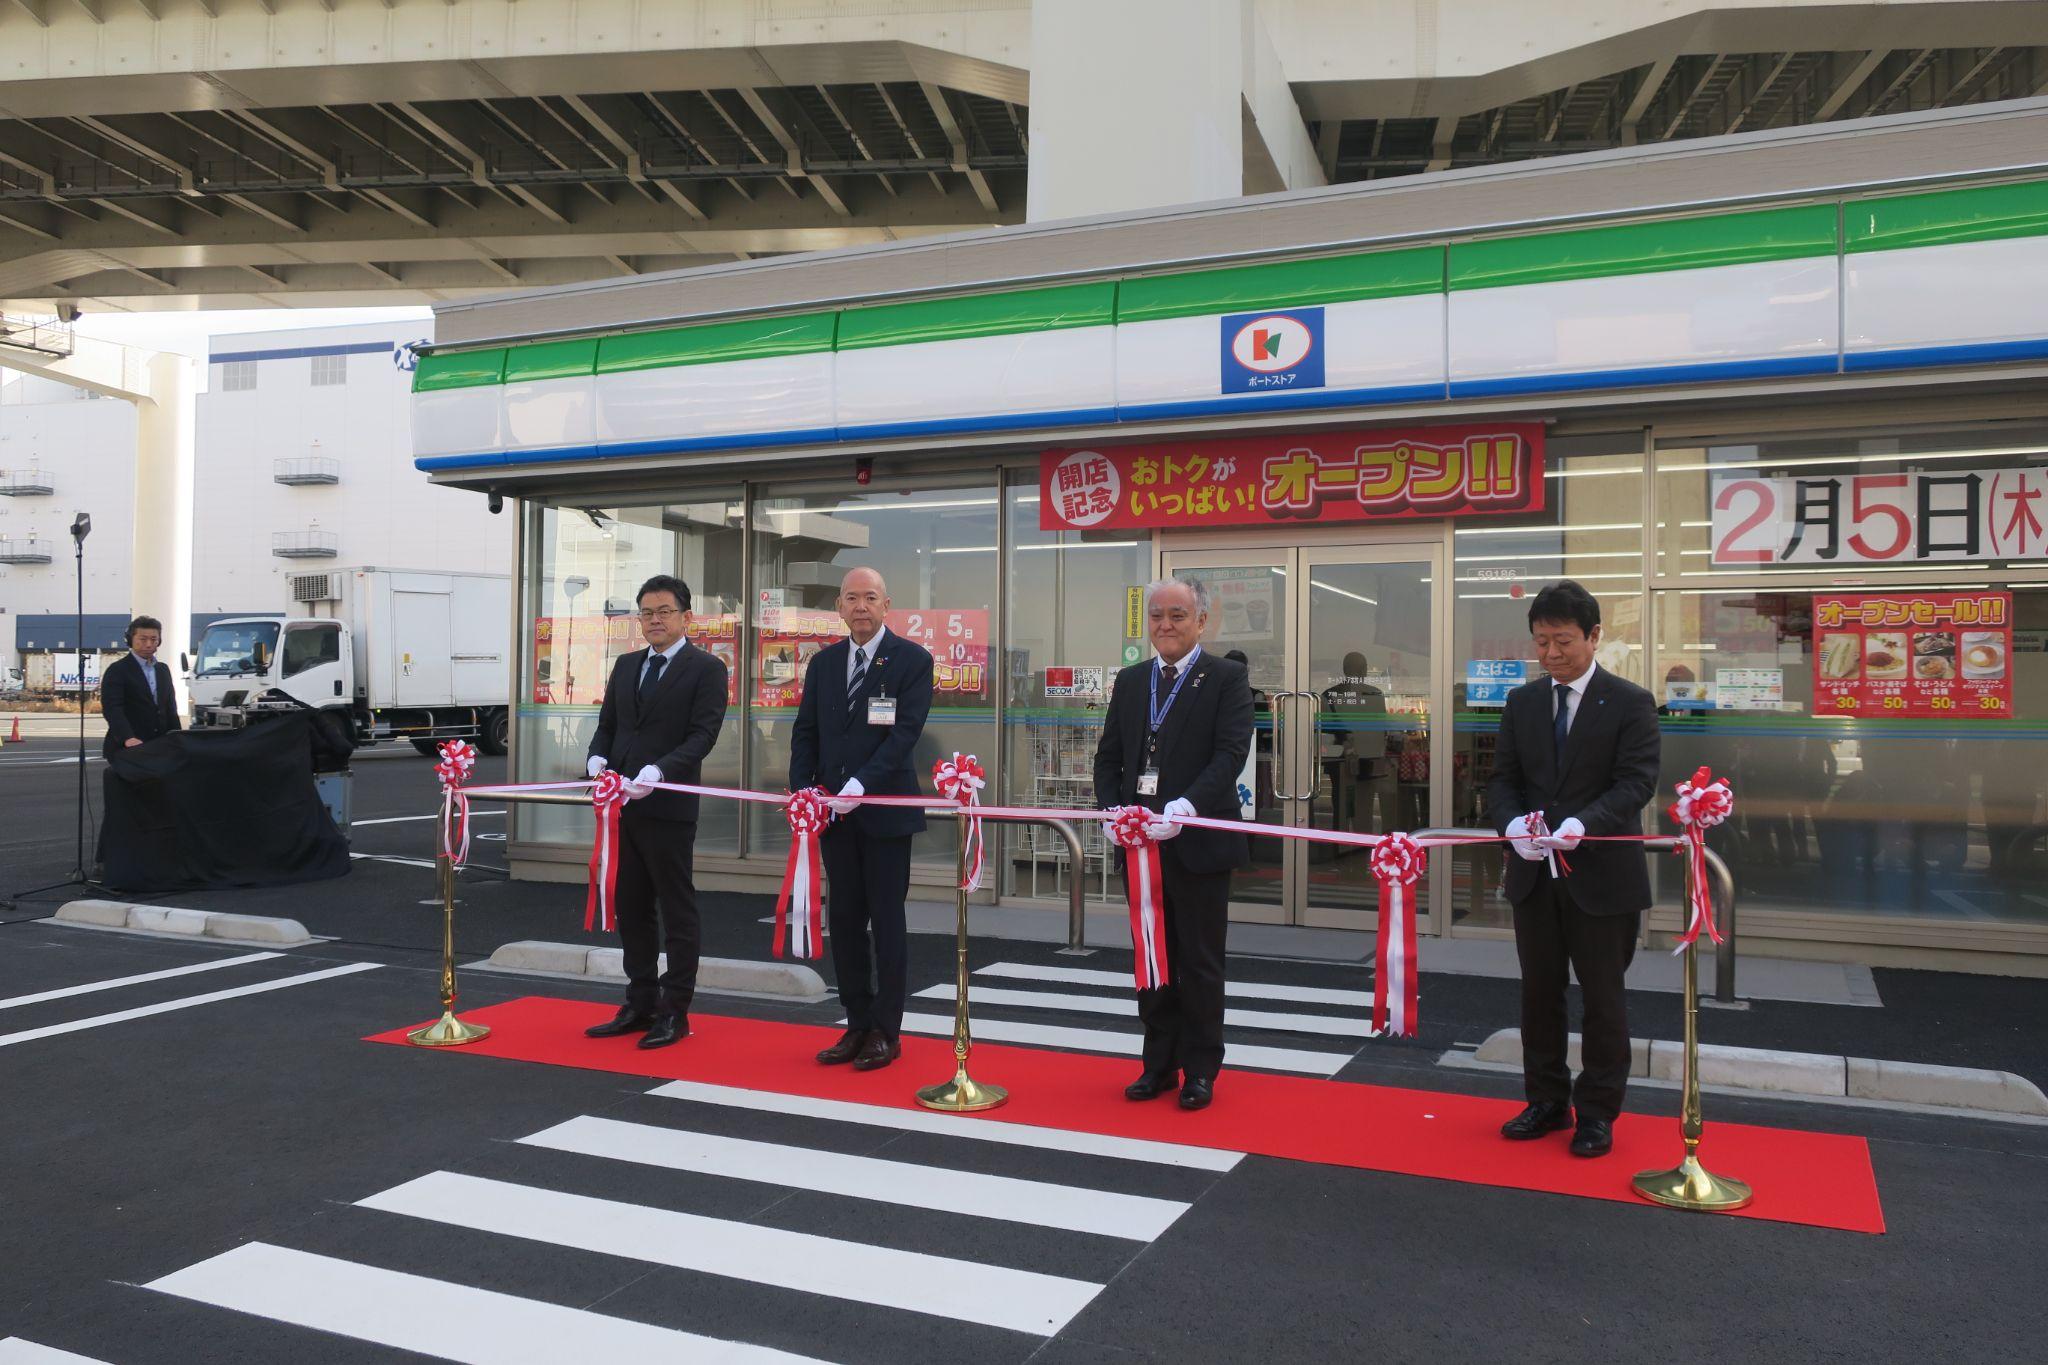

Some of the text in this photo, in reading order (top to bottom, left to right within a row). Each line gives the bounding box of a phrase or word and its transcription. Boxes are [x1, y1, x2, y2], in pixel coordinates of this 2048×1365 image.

[1248, 374, 1297, 386] ポートストア
[1057, 458, 1109, 493] 開店
[1130, 454, 1237, 486] おトクが
[1265, 436, 1519, 506] オープン!!
[1062, 486, 1115, 521] 記念
[1130, 484, 1256, 516] いっぱい!
[1818, 598, 2004, 626] オープンセール!!
[1476, 663, 1517, 676] たばこ
[1836, 697, 1856, 709] 30
[1883, 697, 1903, 709] 50
[1931, 697, 1951, 709] 50
[1979, 697, 2000, 709] 30
